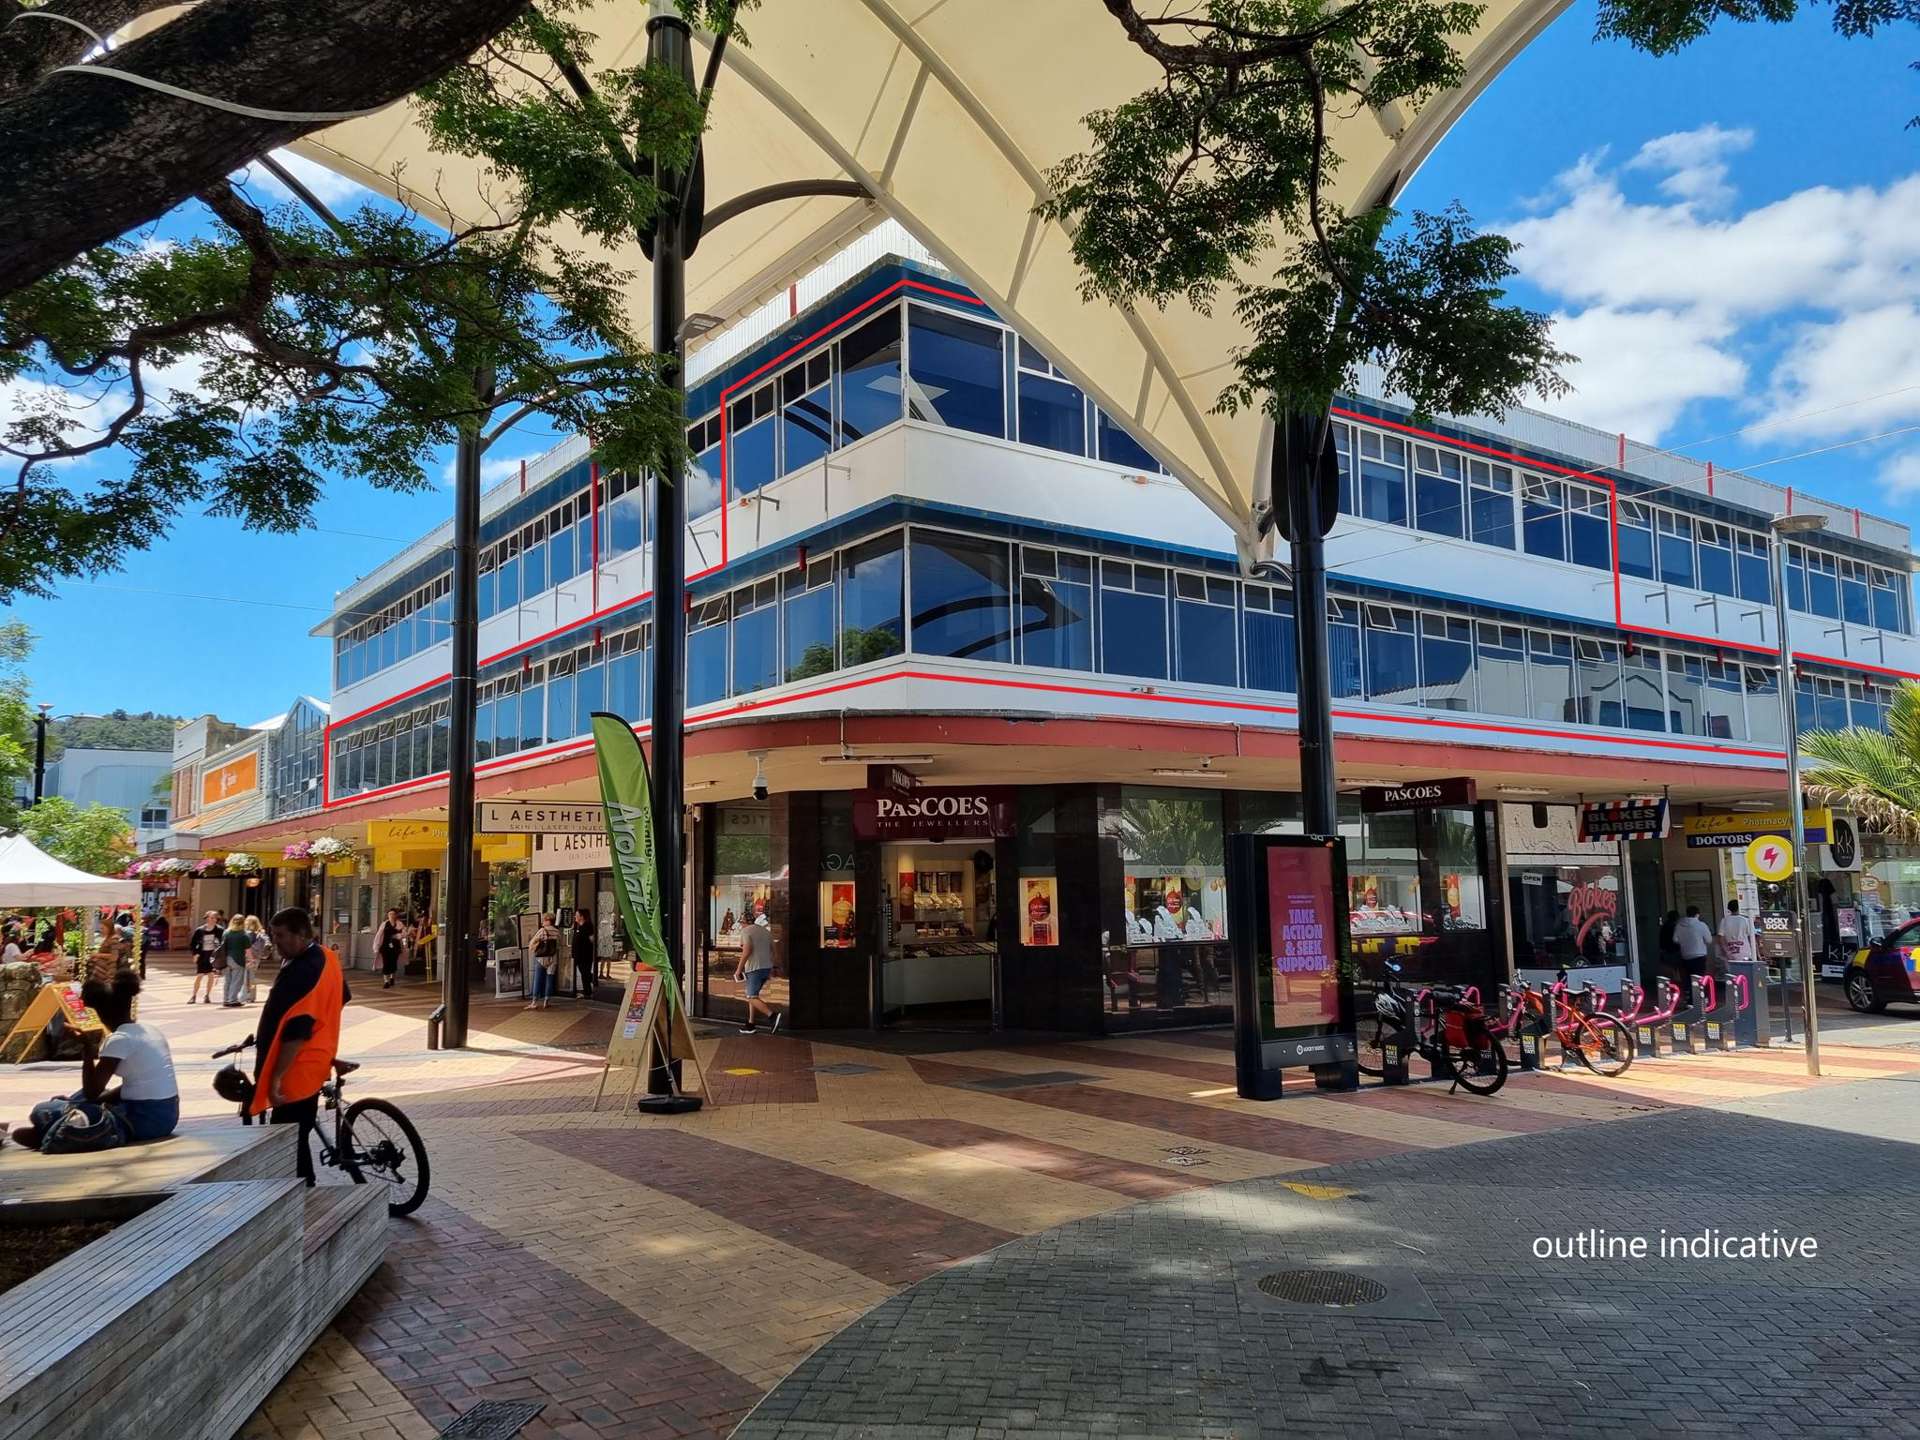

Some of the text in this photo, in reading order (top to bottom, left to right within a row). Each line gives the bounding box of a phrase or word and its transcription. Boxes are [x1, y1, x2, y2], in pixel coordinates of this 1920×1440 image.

[1384, 785, 1442, 802] PASCOES
[876, 797, 990, 817] PASCOES
[492, 810, 499, 821] L
[912, 820, 989, 828] JEWELLERS
[1588, 819, 1657, 833] BARBER
[553, 836, 560, 852] L
[1695, 834, 1753, 846] DOCTORS
[1523, 875, 1541, 883] OPEN
[1568, 881, 1617, 926] Blokes
[1282, 924, 1323, 940] ACTION
[1296, 940, 1322, 955] SEEK
